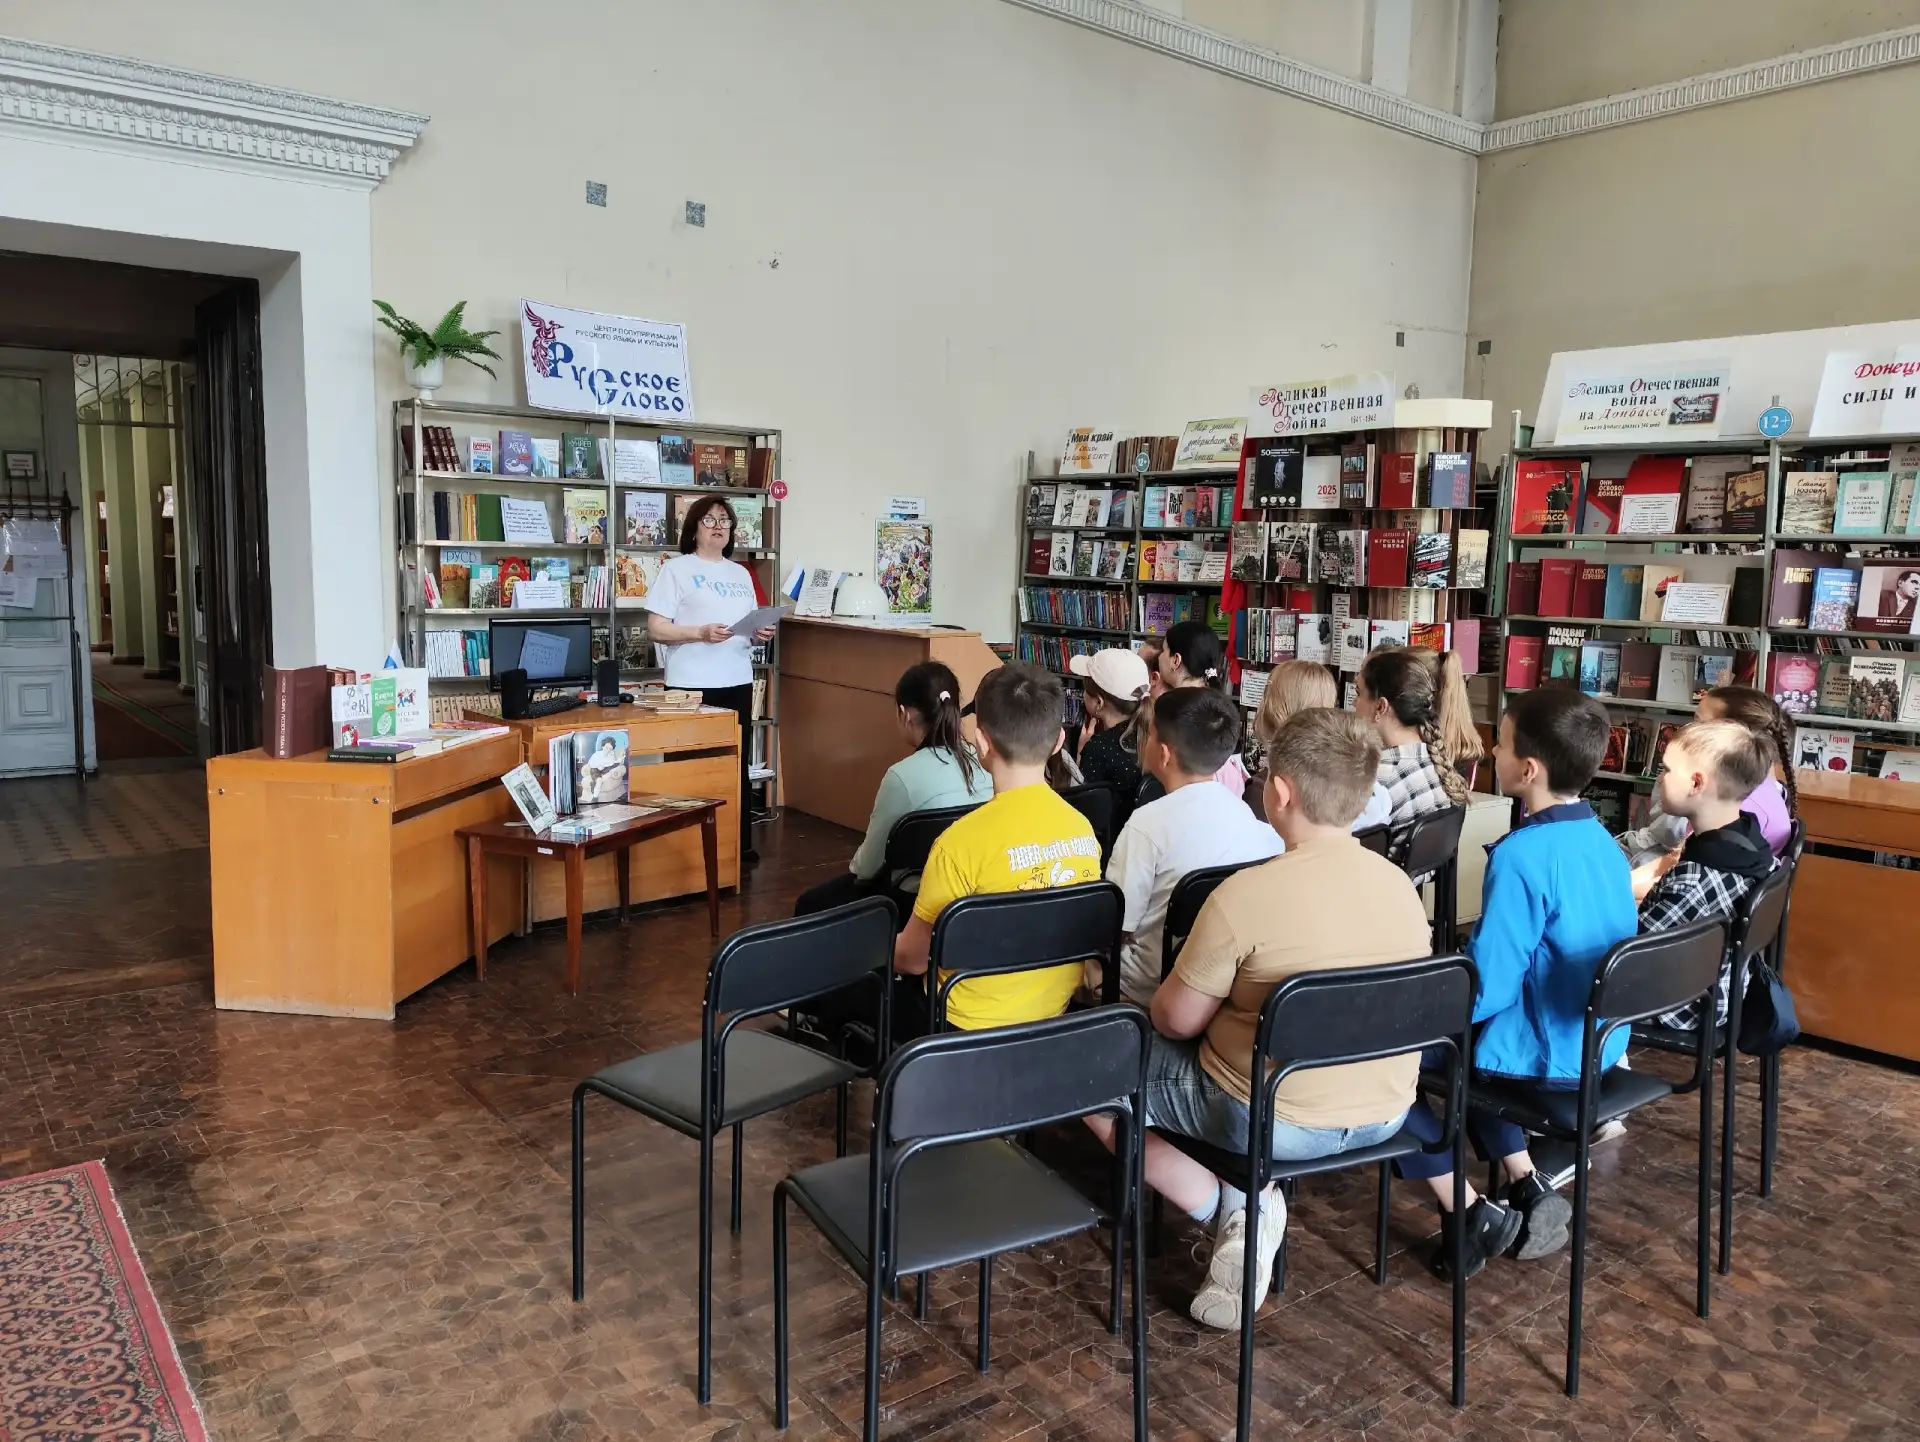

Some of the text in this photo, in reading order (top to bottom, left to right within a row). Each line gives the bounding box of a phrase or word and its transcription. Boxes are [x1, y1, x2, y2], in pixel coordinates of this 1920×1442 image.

[576, 330, 612, 341] РУССКОГО
[613, 334, 636, 344] ЯЗЫКА
[644, 339, 678, 349] КУЛЬТУРЫ
[594, 324, 678, 341] ЦЕНТР ПОПУЛЯРИЗАЦИИ
[1568, 376, 1720, 398] Великая Отечественная
[1259, 386, 1327, 406] Великая
[1612, 393, 1657, 406] война
[1842, 388, 1894, 404] силы
[1272, 394, 1383, 418] Отечественная
[1580, 412, 1594, 420] на
[1600, 407, 1668, 420] Донбассе
[1274, 416, 1326, 433] Война
[1762, 415, 1790, 429] 12+
[1071, 431, 1114, 443] Мой край
[1318, 485, 1337, 495] 2025
[444, 550, 477, 563] РУСЬ
[1549, 627, 1586, 638] ПОДВИГ
[1548, 636, 1585, 647] НАРОДА
